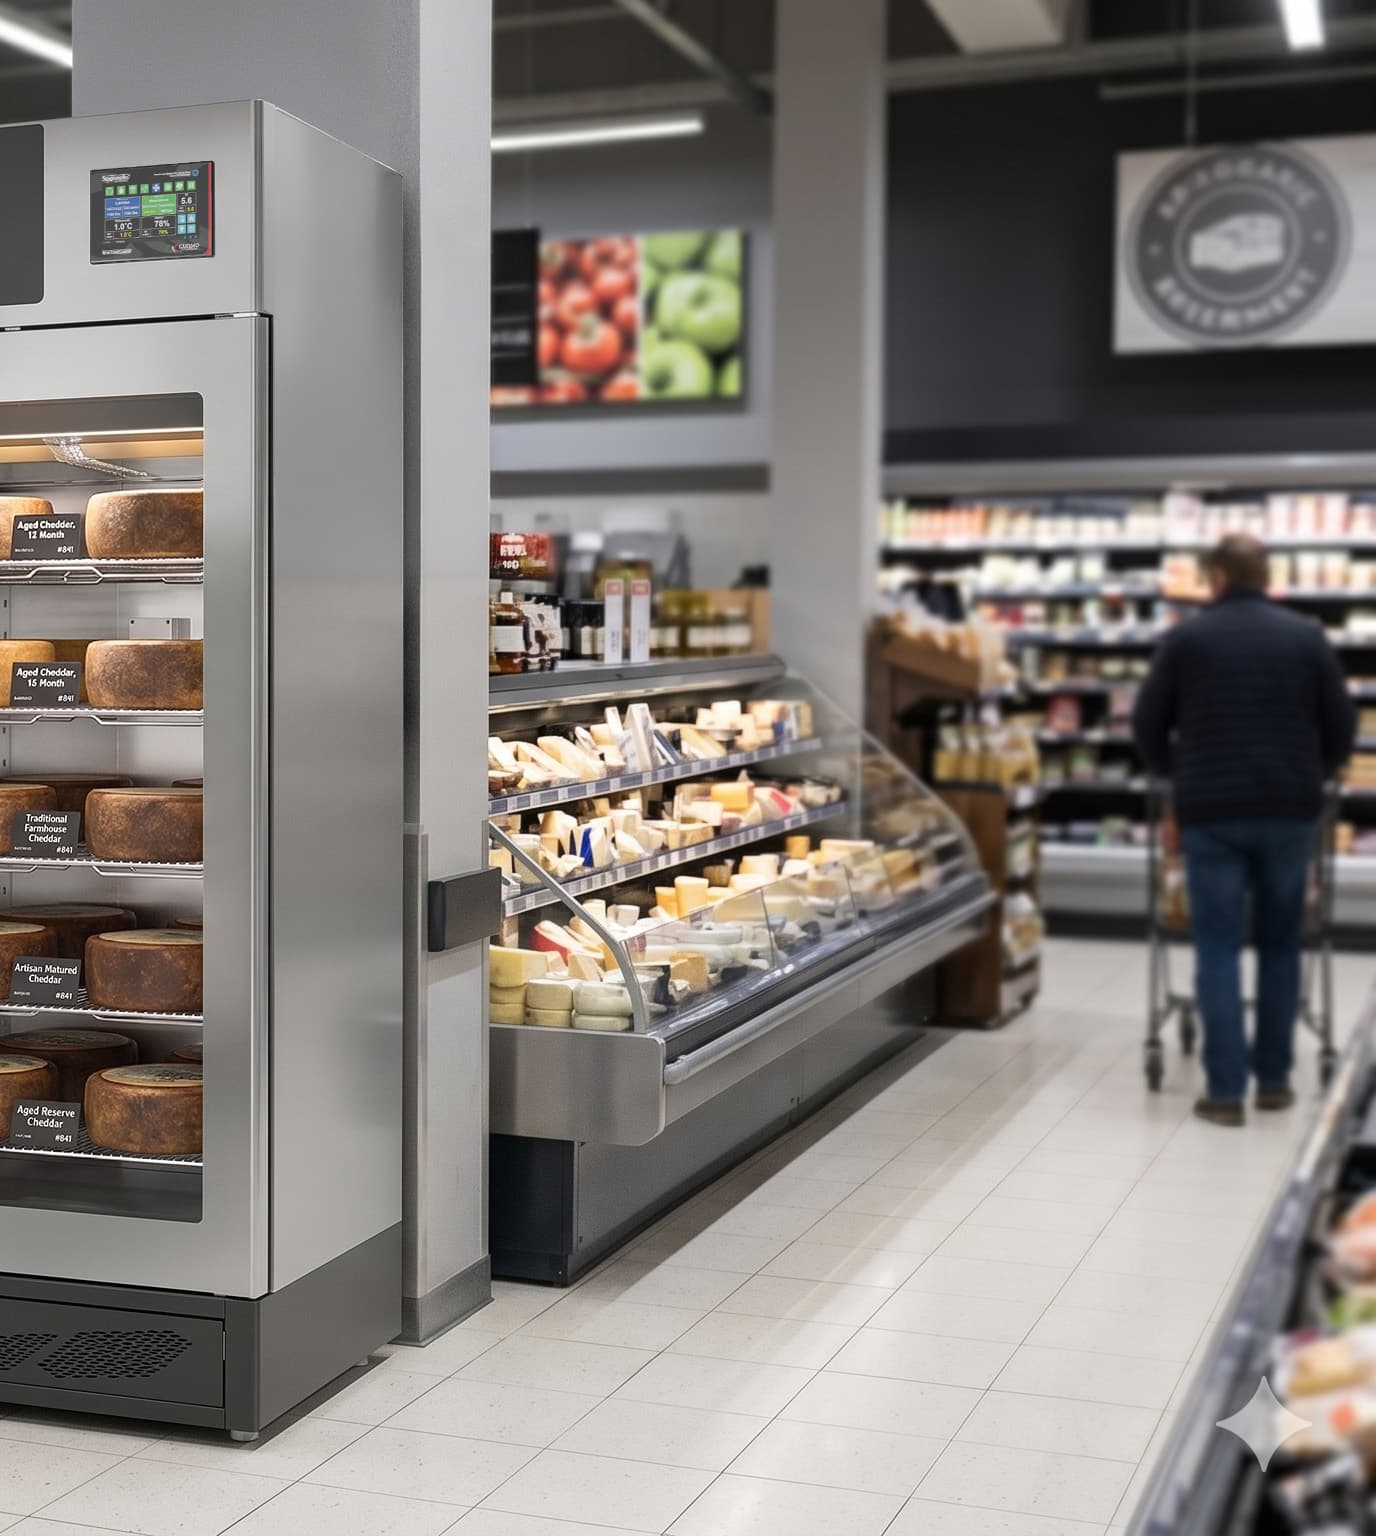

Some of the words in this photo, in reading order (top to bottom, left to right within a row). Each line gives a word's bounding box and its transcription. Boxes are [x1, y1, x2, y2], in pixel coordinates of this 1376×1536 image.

[17, 521, 39, 531] Aged
[28, 531, 37, 539] 12
[39, 530, 65, 539] Month
[16, 667, 39, 678] Aged
[40, 667, 77, 678] Cheddar,
[27, 679, 37, 687] 15
[39, 679, 65, 687] Month
[26, 813, 68, 823] Traditional
[24, 824, 68, 833] Farmhouse
[28, 834, 62, 843] Cheddar
[14, 962, 43, 973] Artisan
[44, 964, 78, 975] Matured
[28, 974, 62, 984] Cheddar
[17, 1105, 40, 1116] Aged
[41, 1106, 75, 1118] Reserve
[27, 1117, 64, 1128] Cheddar
